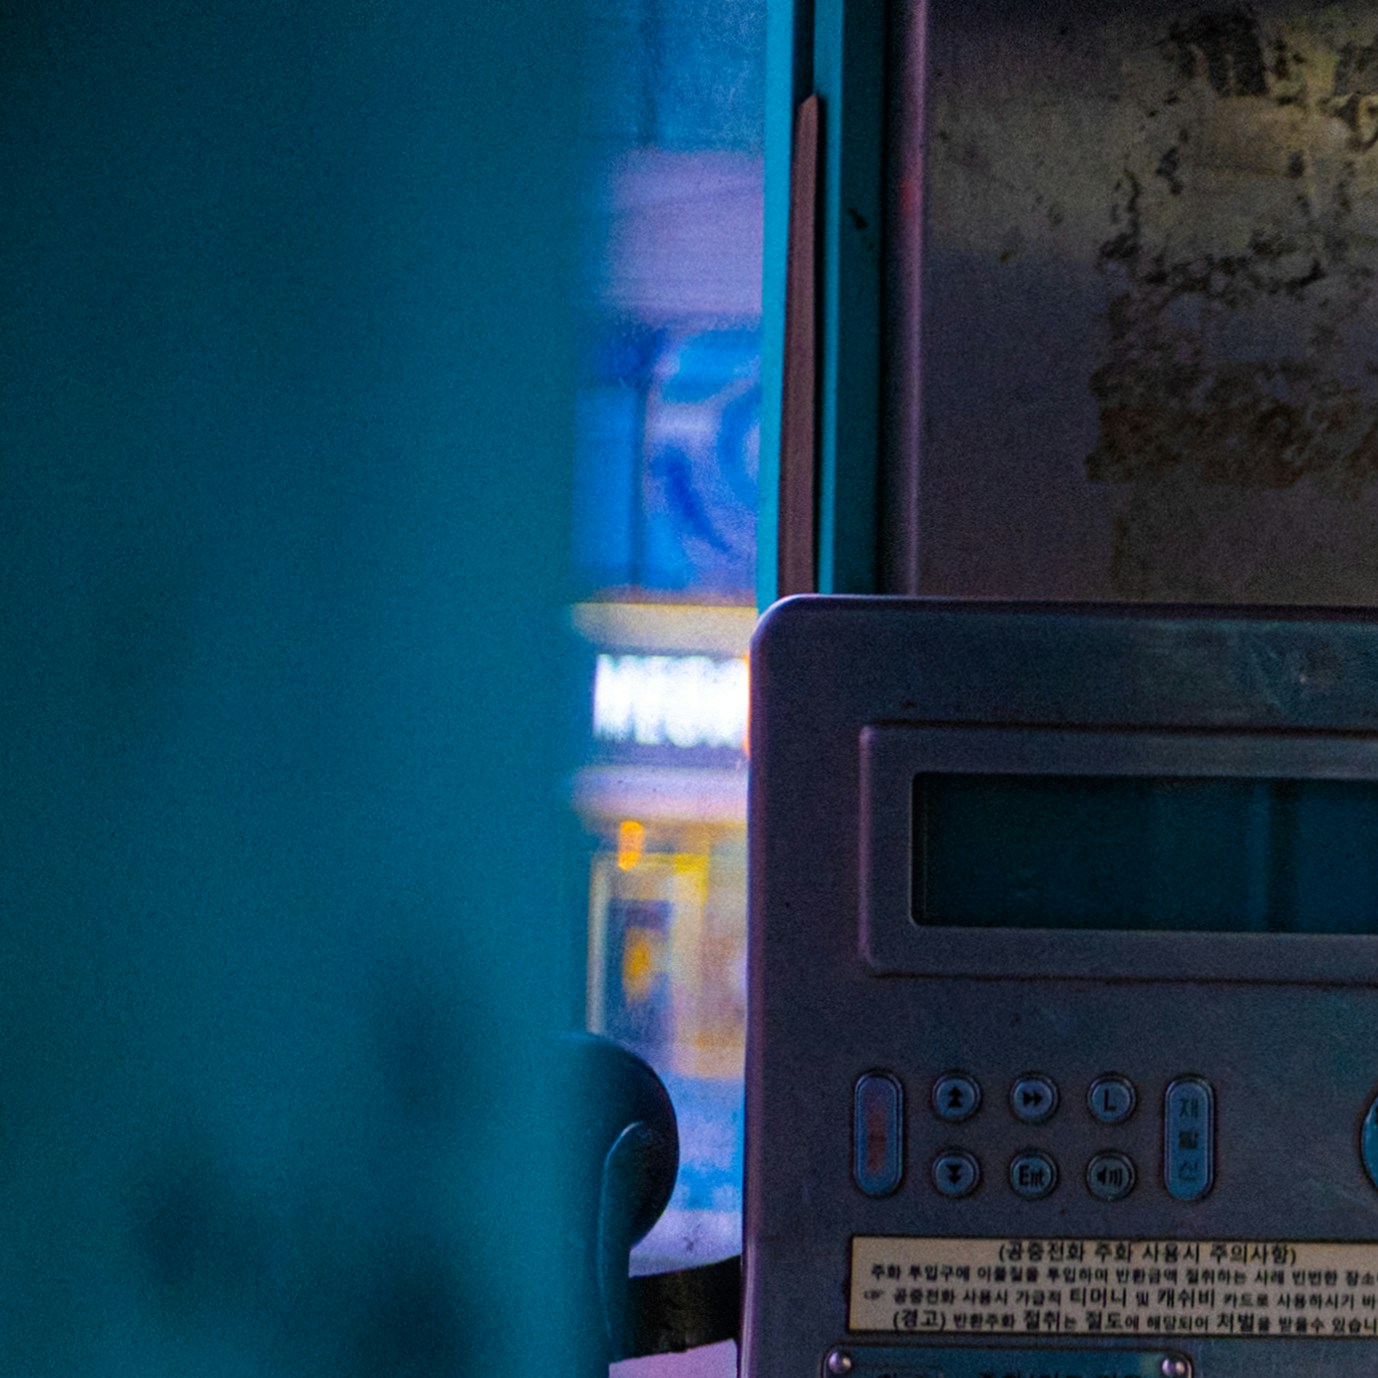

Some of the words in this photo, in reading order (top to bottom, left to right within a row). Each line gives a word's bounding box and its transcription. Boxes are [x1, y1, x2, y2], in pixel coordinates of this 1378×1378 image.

[1104, 1090, 1117, 1111] L
[1019, 1166, 1045, 1186] Ent
[999, 1242, 1084, 1262] (공중전화
[1094, 1242, 1132, 1263] 주화
[1141, 1243, 1200, 1263] 사용시
[1210, 1244, 1297, 1265] 주의사항)
[871, 1264, 901, 1281] 주화
[908, 1265, 970, 1282] 투입구에
[978, 1265, 1039, 1282] 이물질을
[1116, 1267, 1178, 1285] 반환금액
[1185, 1269, 1247, 1285] 절취하는
[1254, 1270, 1285, 1286] 사례
[1292, 1270, 1338, 1286] 빈번한
[893, 1289, 955, 1306] 공중전화
[962, 1290, 1008, 1306] 사용시
[1016, 1290, 1062, 1306] 가급적
[1070, 1287, 1127, 1307] 티머니
[1157, 1288, 1216, 1308] 캐쉬비
[1224, 1292, 1269, 1308] 카드로
[1277, 1293, 1354, 1311] 사용하시기
[893, 1310, 947, 1331] (경고)
[953, 1312, 1016, 1330] 반환주화
[1023, 1310, 1078, 1332] 절취는
[1085, 1311, 1140, 1331] 절도에
[1147, 1315, 1209, 1331] 해당되어
[1216, 1312, 1271, 1332] 처벌을
